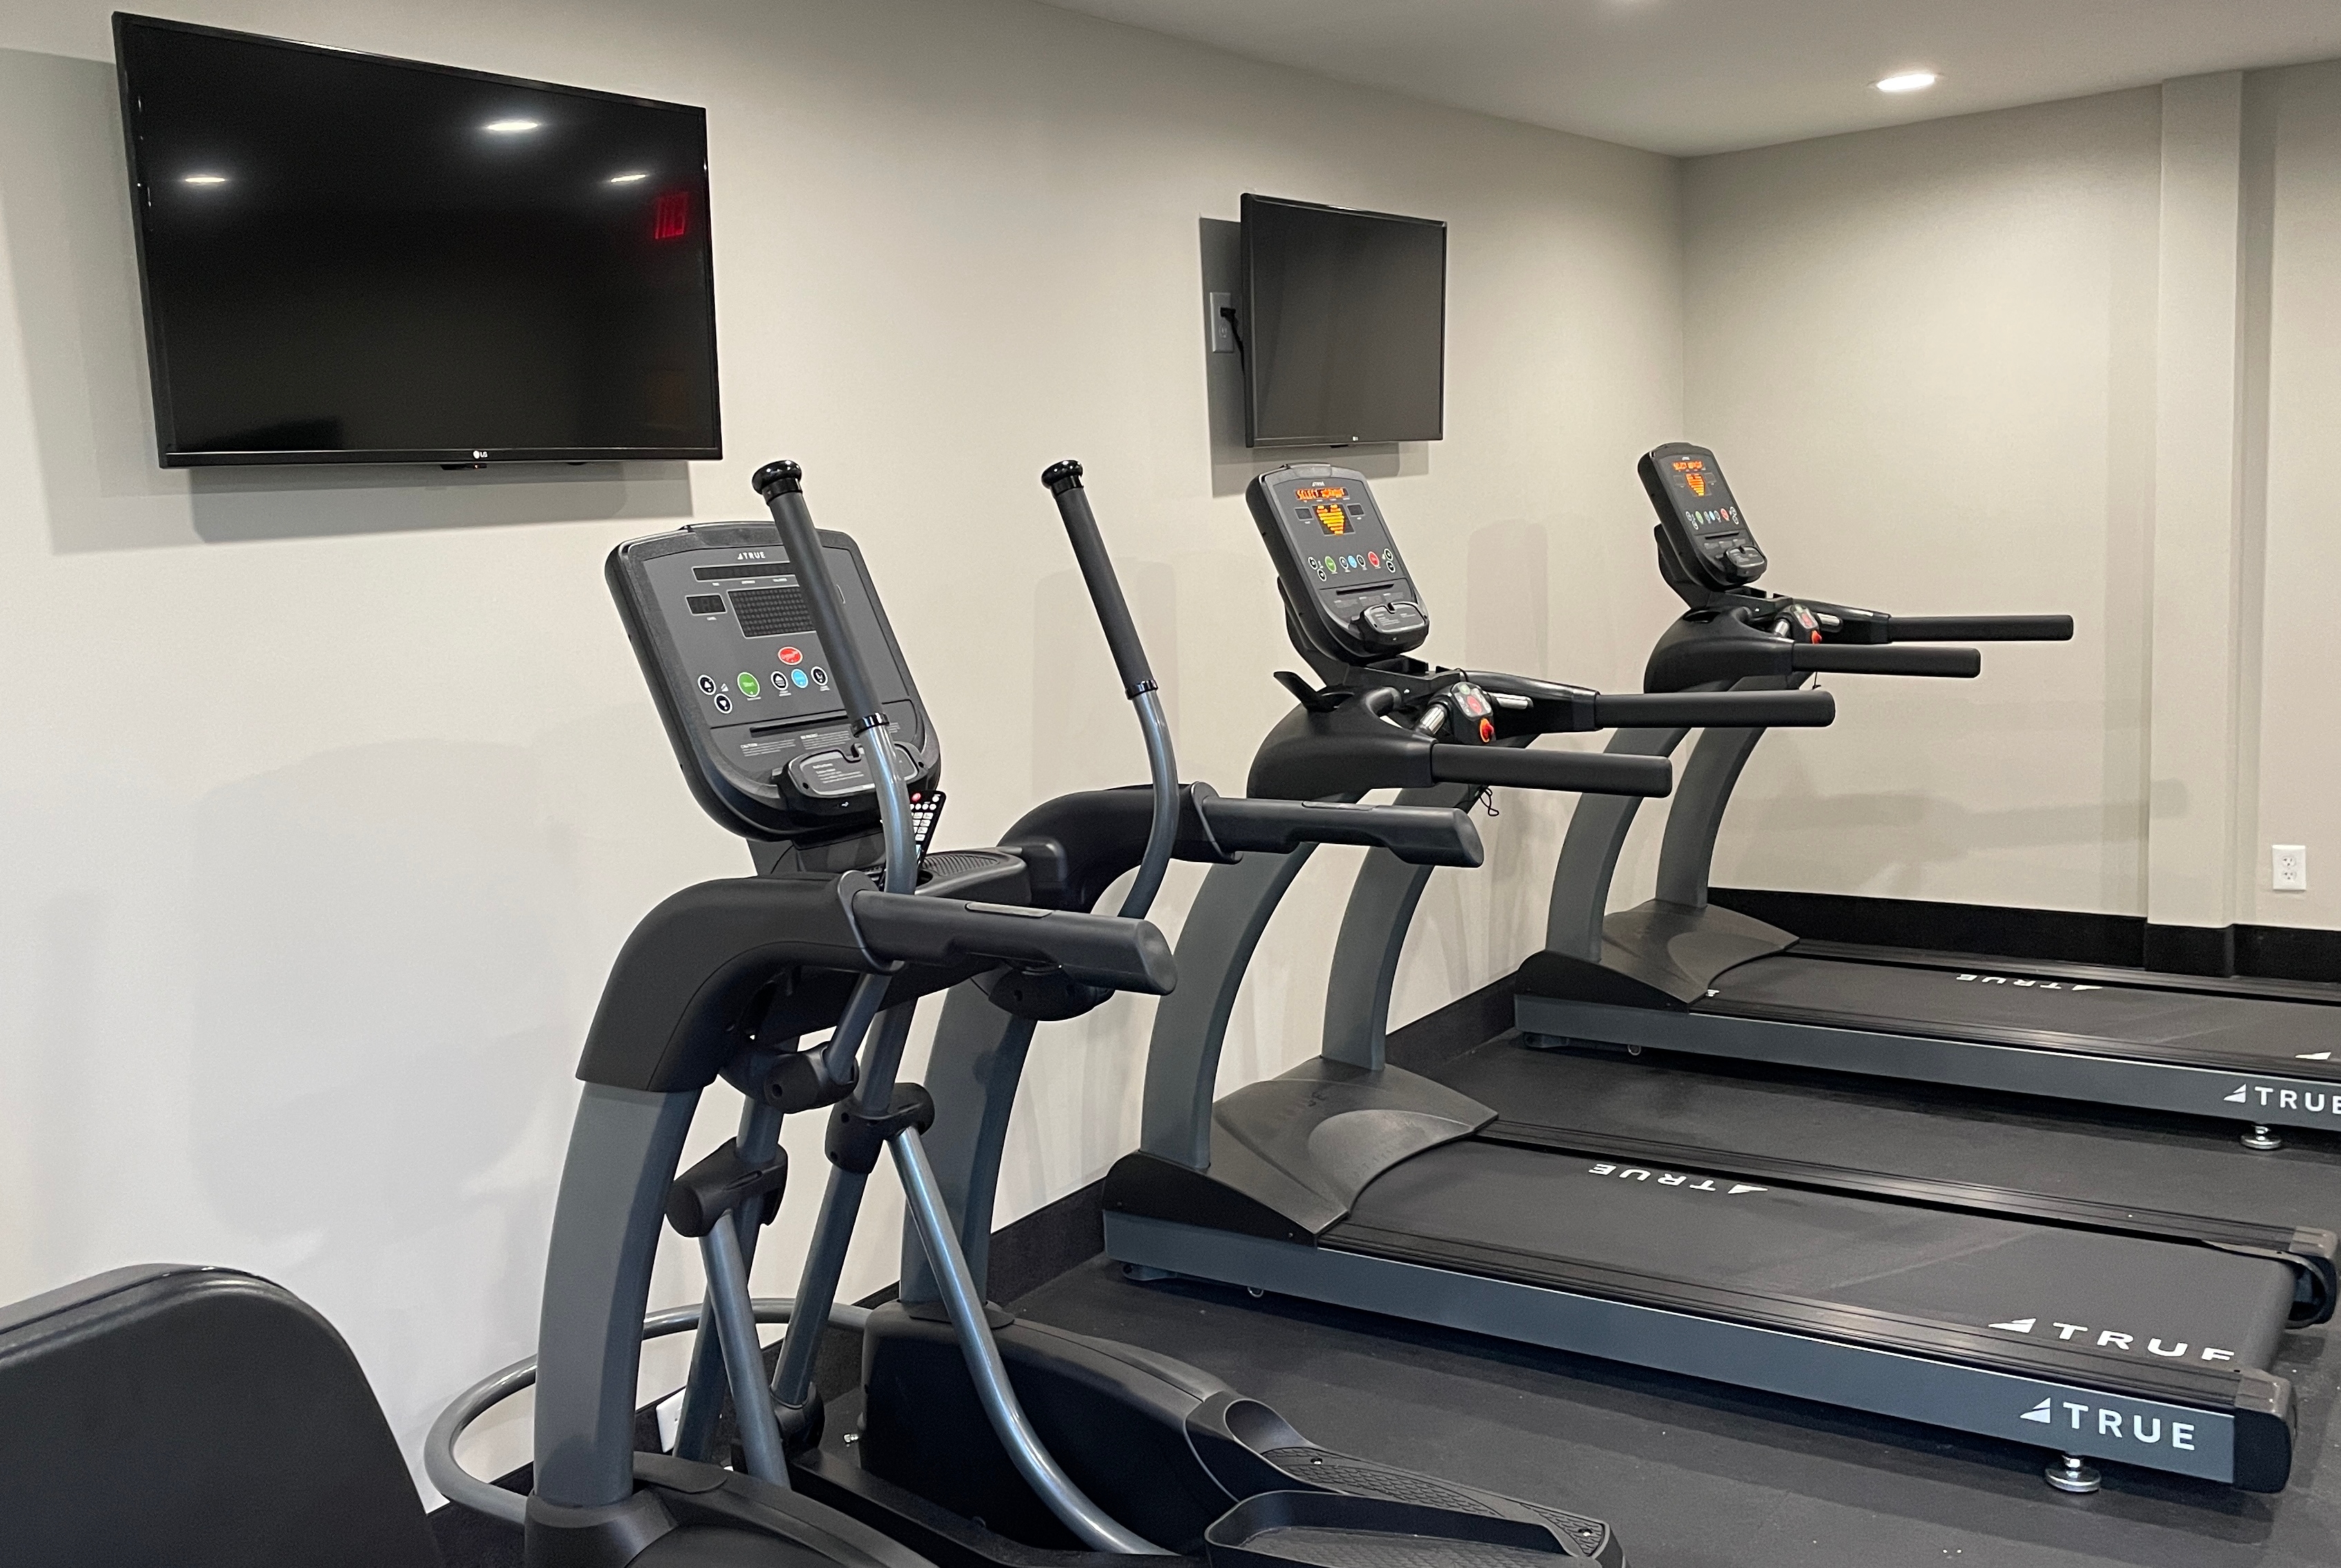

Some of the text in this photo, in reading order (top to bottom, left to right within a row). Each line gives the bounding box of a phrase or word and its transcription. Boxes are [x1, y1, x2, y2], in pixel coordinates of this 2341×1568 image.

[743, 551, 766, 559] TRUE
[1589, 1163, 1716, 1192] TRUE
[2062, 1401, 2196, 1451] TRUE
